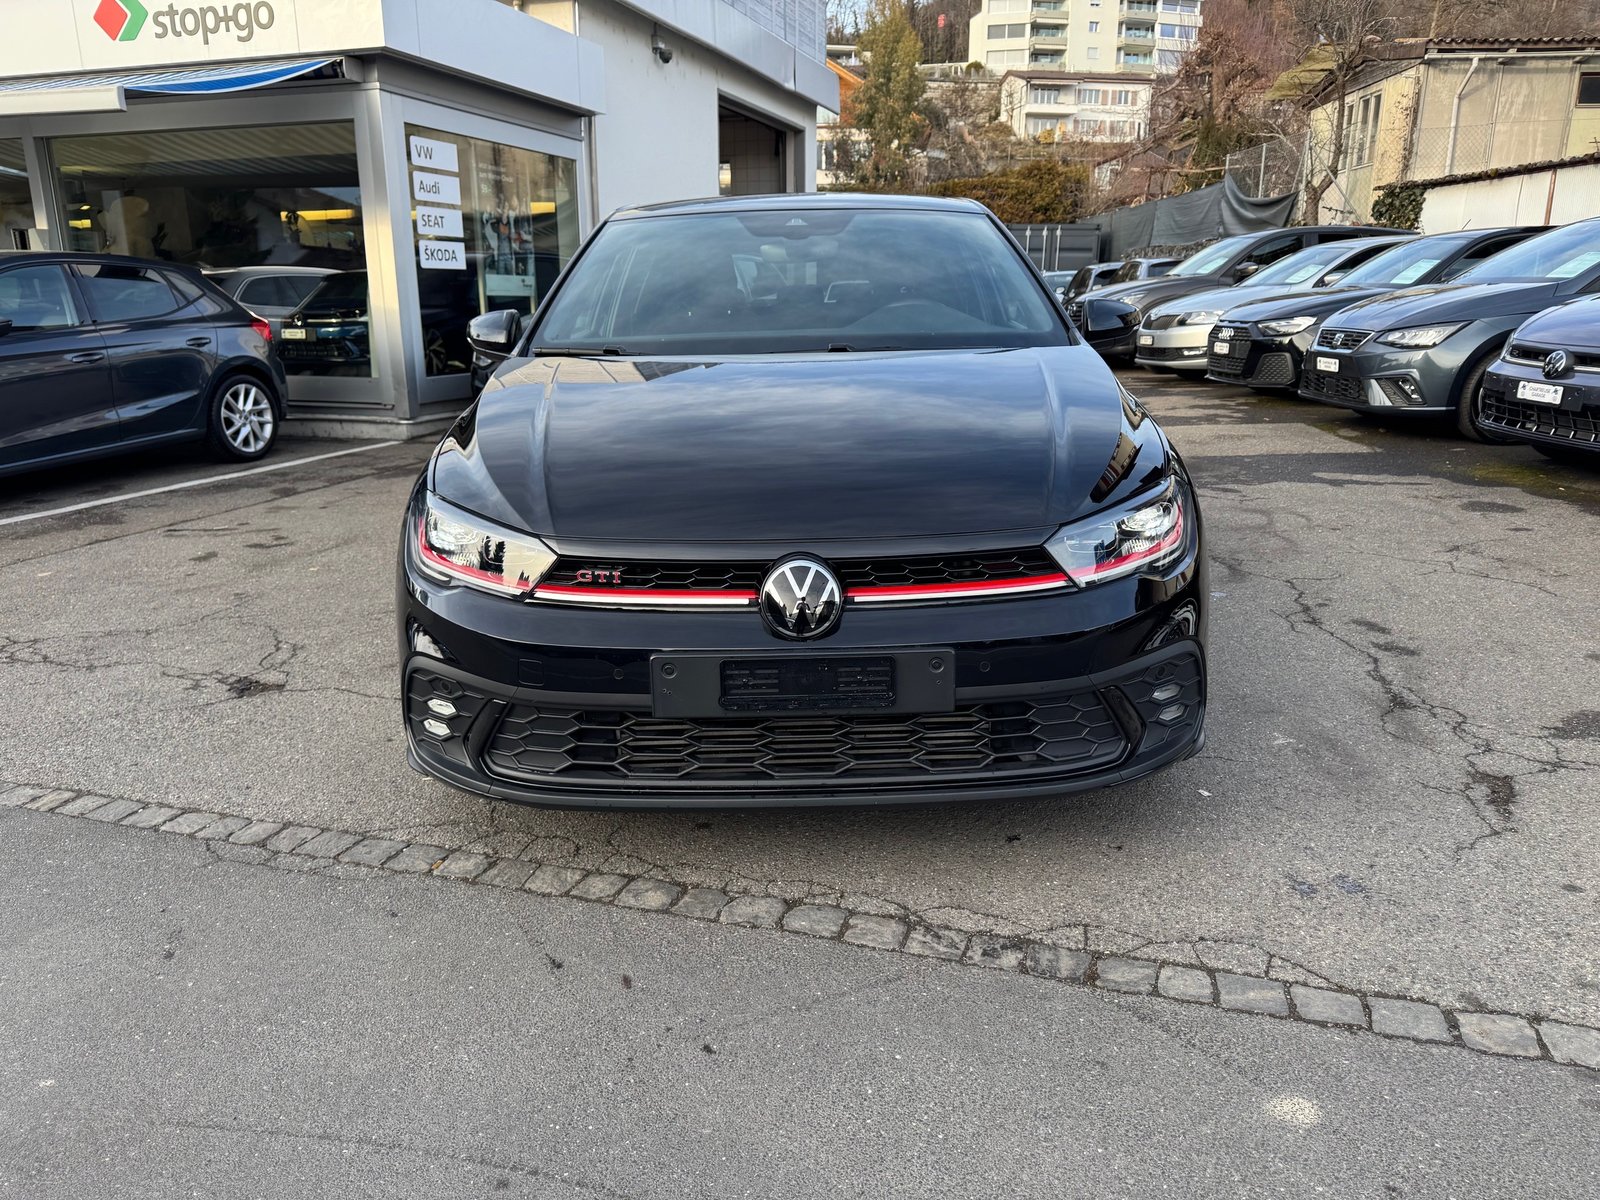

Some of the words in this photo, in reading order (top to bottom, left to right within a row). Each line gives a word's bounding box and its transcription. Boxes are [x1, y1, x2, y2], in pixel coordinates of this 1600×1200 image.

[152, 1, 275, 45] stop+go
[415, 144, 433, 160] VW
[418, 180, 441, 195] Audi
[421, 214, 445, 228] SEAT
[424, 245, 458, 262] ŠKODA
[576, 569, 621, 584] GTI
